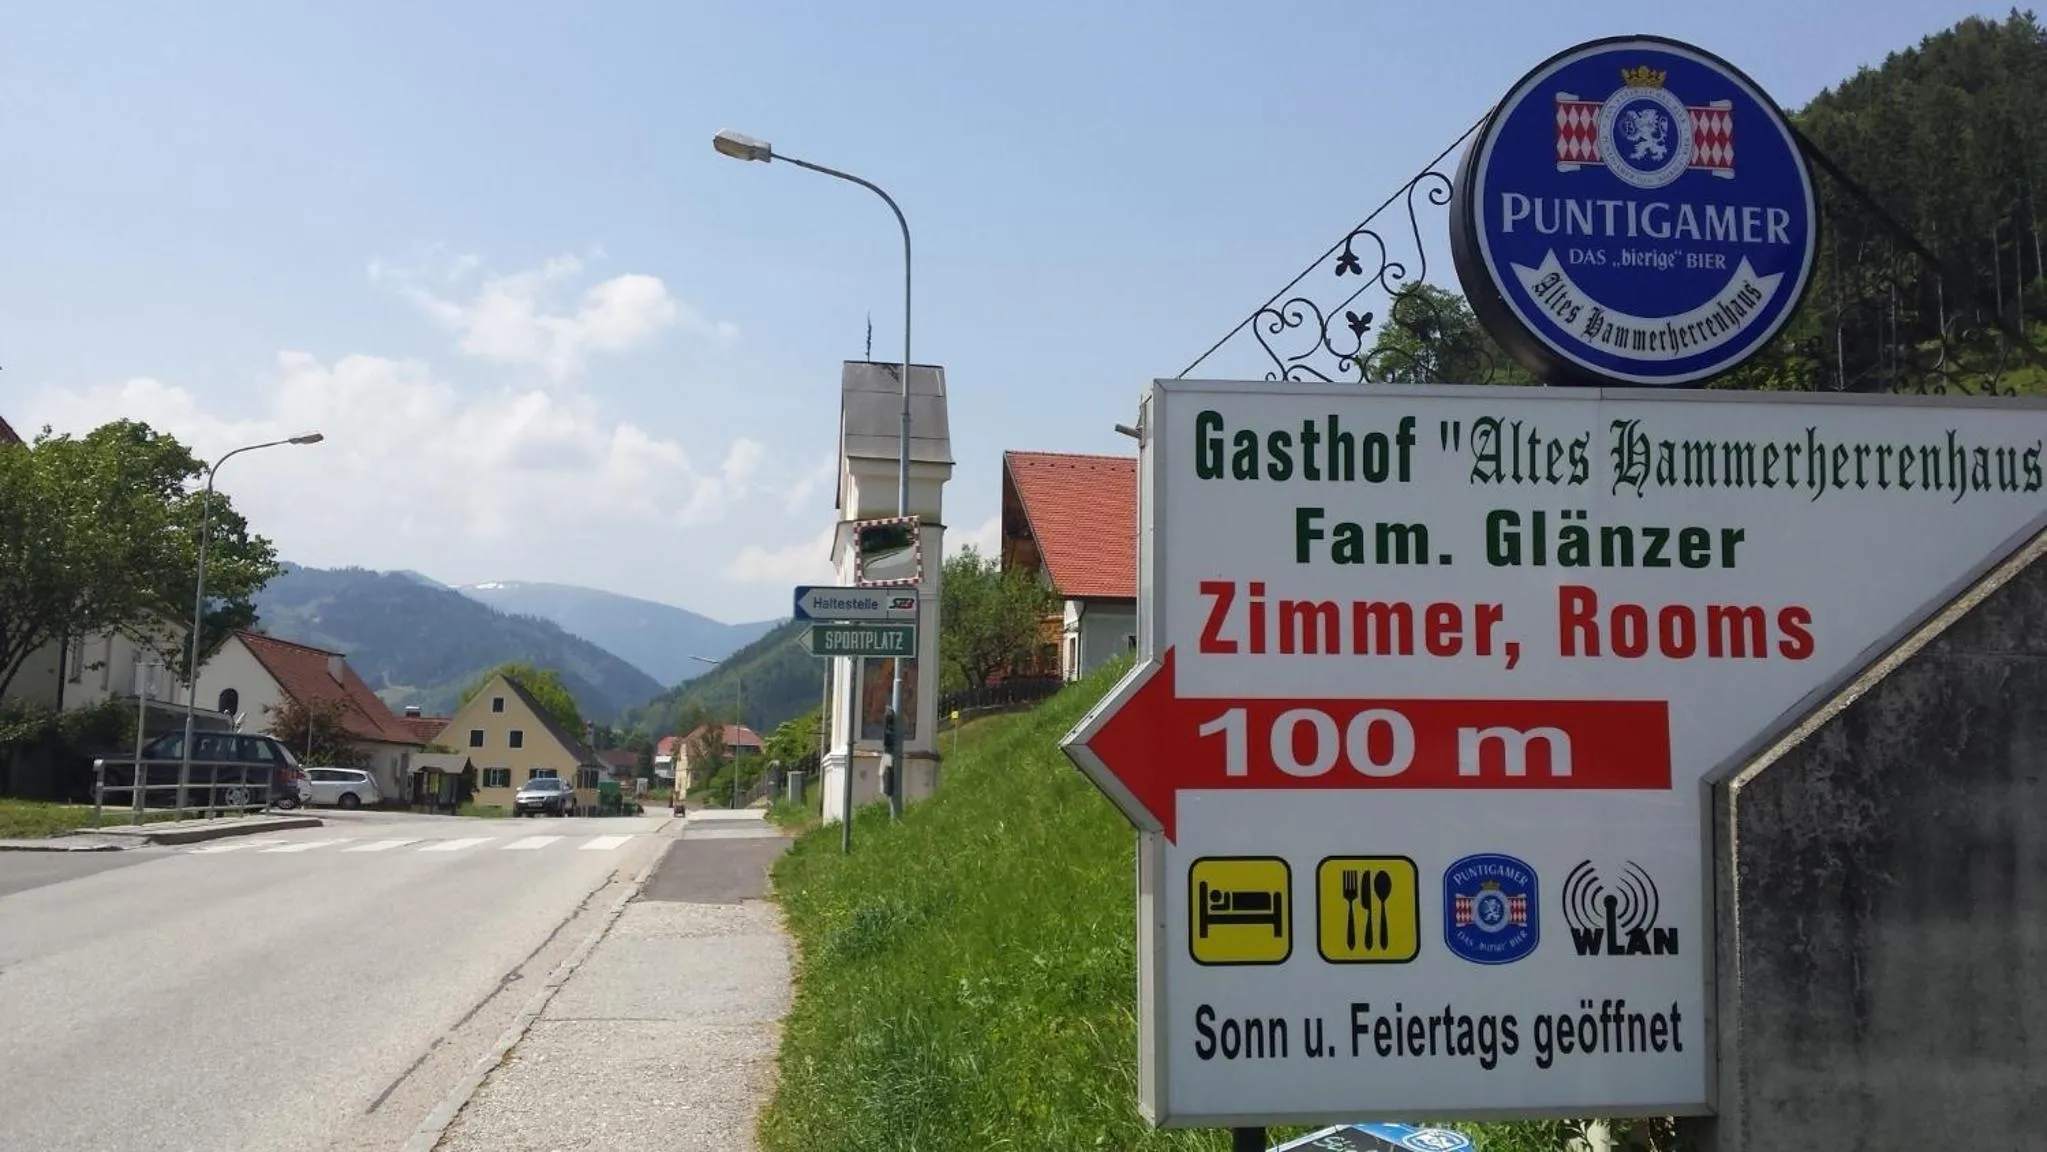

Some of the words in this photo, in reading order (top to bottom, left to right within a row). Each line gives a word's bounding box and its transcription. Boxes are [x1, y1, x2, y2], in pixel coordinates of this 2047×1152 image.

[1501, 192, 1790, 244] PUNTIGAMER
[1569, 248, 1606, 265] DAS
[1687, 253, 1726, 269] BIER
[1531, 271, 1579, 323] Altes
[1584, 279, 1763, 357] Hammerherrenhaus
[1195, 410, 1416, 483] Gasthof
[1440, 415, 1591, 486] "Altes
[1609, 418, 2043, 504] Hammerherrenhaus
[1295, 507, 1452, 566] Fam.
[1486, 508, 1745, 568] Glänzer
[813, 597, 878, 610] Haltestelle
[1199, 581, 1521, 670] Zimmer,
[1559, 585, 1815, 660] Rooms
[825, 631, 904, 650] SPORTPLATZ
[1199, 707, 1416, 777] 100
[1458, 726, 1573, 777] m
[1453, 864, 1528, 888] PUNTIGAMER
[1569, 918, 1679, 956] WLAN
[1195, 1004, 1288, 1060] Sonn
[1304, 1020, 1336, 1058] u.
[1351, 1003, 1520, 1070] Feiertags
[1534, 1000, 1683, 1070] geöffnet
